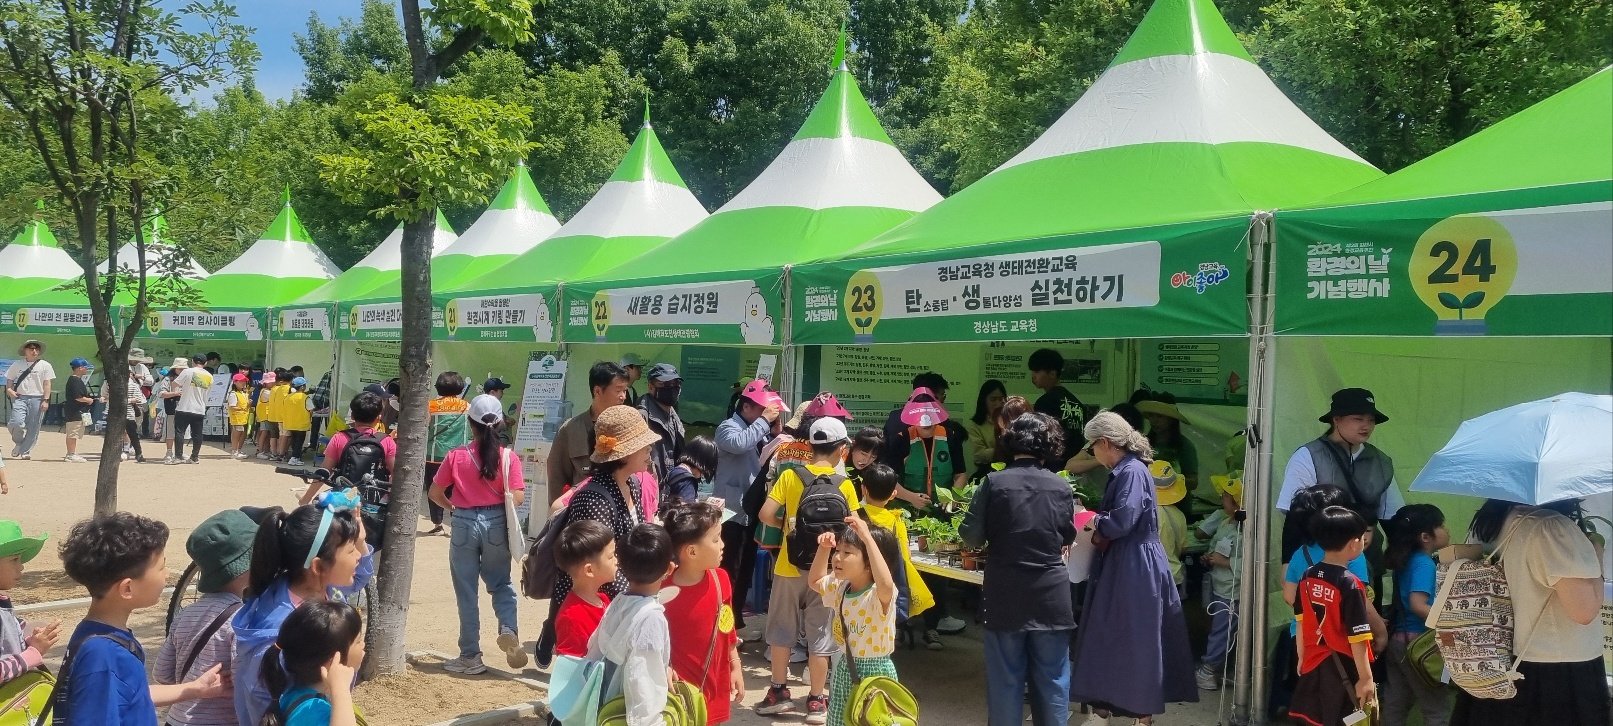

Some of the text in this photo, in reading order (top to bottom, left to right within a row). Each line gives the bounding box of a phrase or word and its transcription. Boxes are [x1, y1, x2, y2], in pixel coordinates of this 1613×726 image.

[1307, 243, 1342, 255] 2024
[938, 255, 1077, 282] 경남교육청 생태전환교육
[1307, 254, 1390, 276] 환경의 날
[1428, 239, 1496, 284] 24
[1030, 274, 1124, 306] 실천하기
[1307, 278, 1391, 299] 기념행사
[627, 292, 719, 316] 새활용 습지정원
[852, 285, 876, 312] 23
[18, 313, 26, 322] 17
[35, 313, 54, 321] 나만의
[448, 308, 456, 323] 21
[492, 309, 504, 324] 키링
[506, 309, 525, 324] 만들기
[595, 301, 608, 320] 22
[805, 309, 838, 322] 기념행사
[150, 317, 159, 326] 18
[172, 316, 236, 327] 커피박 업사이클링
[974, 319, 1037, 333] 경상남도 교육청
[1306, 582, 1335, 602] 광민
